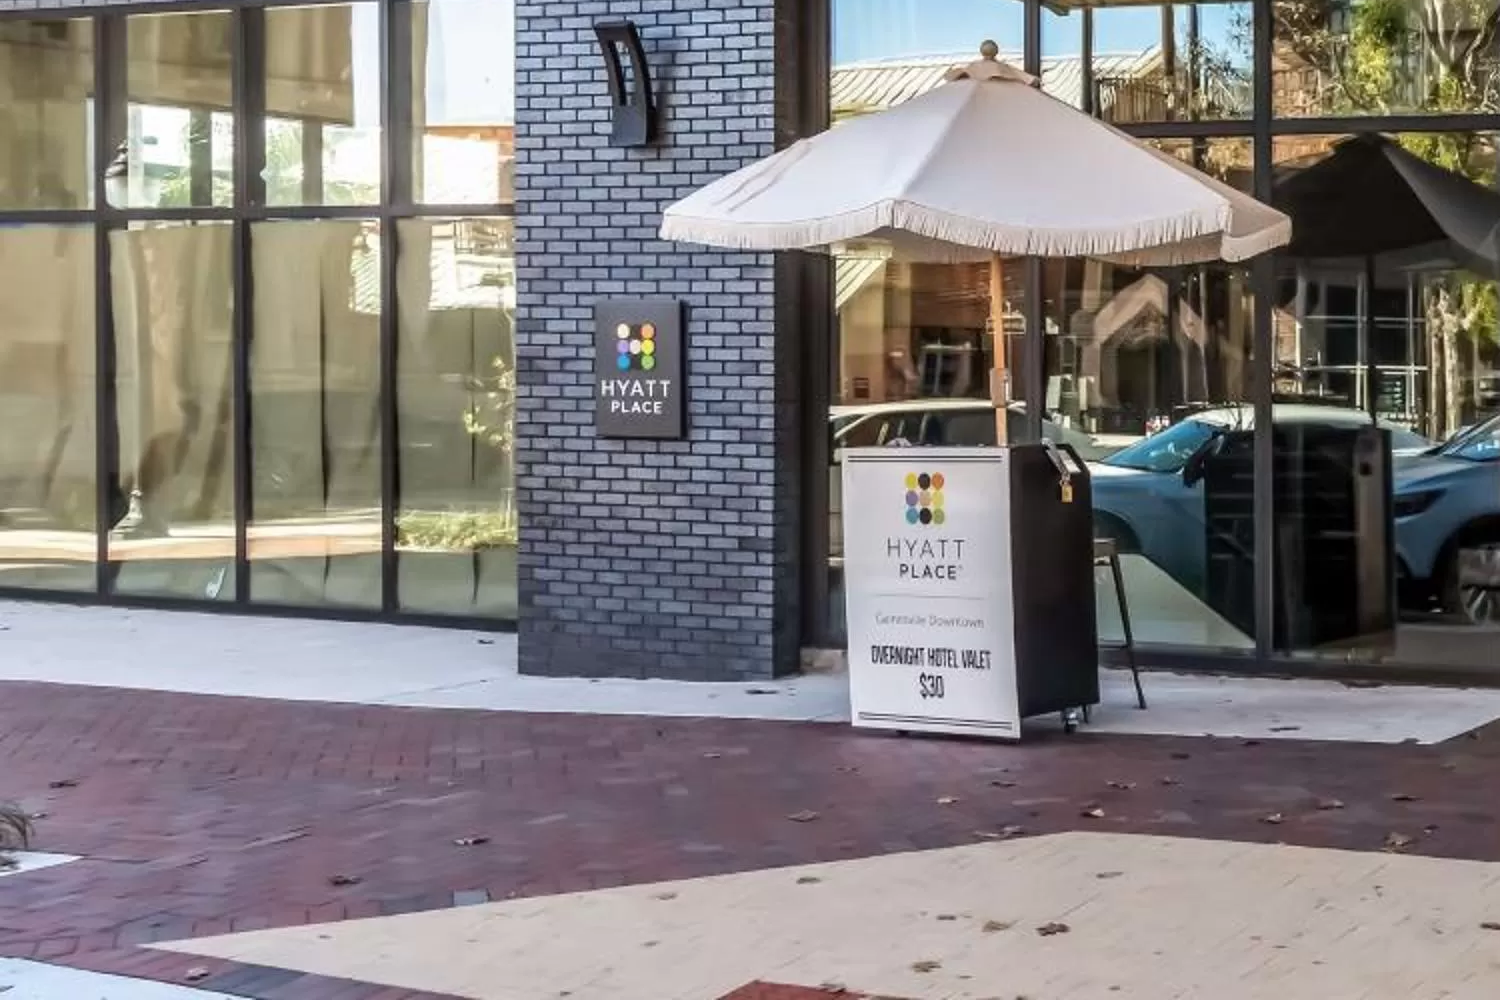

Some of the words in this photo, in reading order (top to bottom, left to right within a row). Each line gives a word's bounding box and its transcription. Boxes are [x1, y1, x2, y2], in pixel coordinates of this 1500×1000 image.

[601, 379, 671, 397] HYATT
[611, 400, 662, 414] PLACE
[887, 537, 965, 559] HYATT
[899, 563, 957, 580] PLACE
[871, 645, 925, 667] OVERNIGHT
[927, 647, 959, 669] HOTEL
[961, 649, 992, 670] VALET
[919, 671, 945, 700] $30
